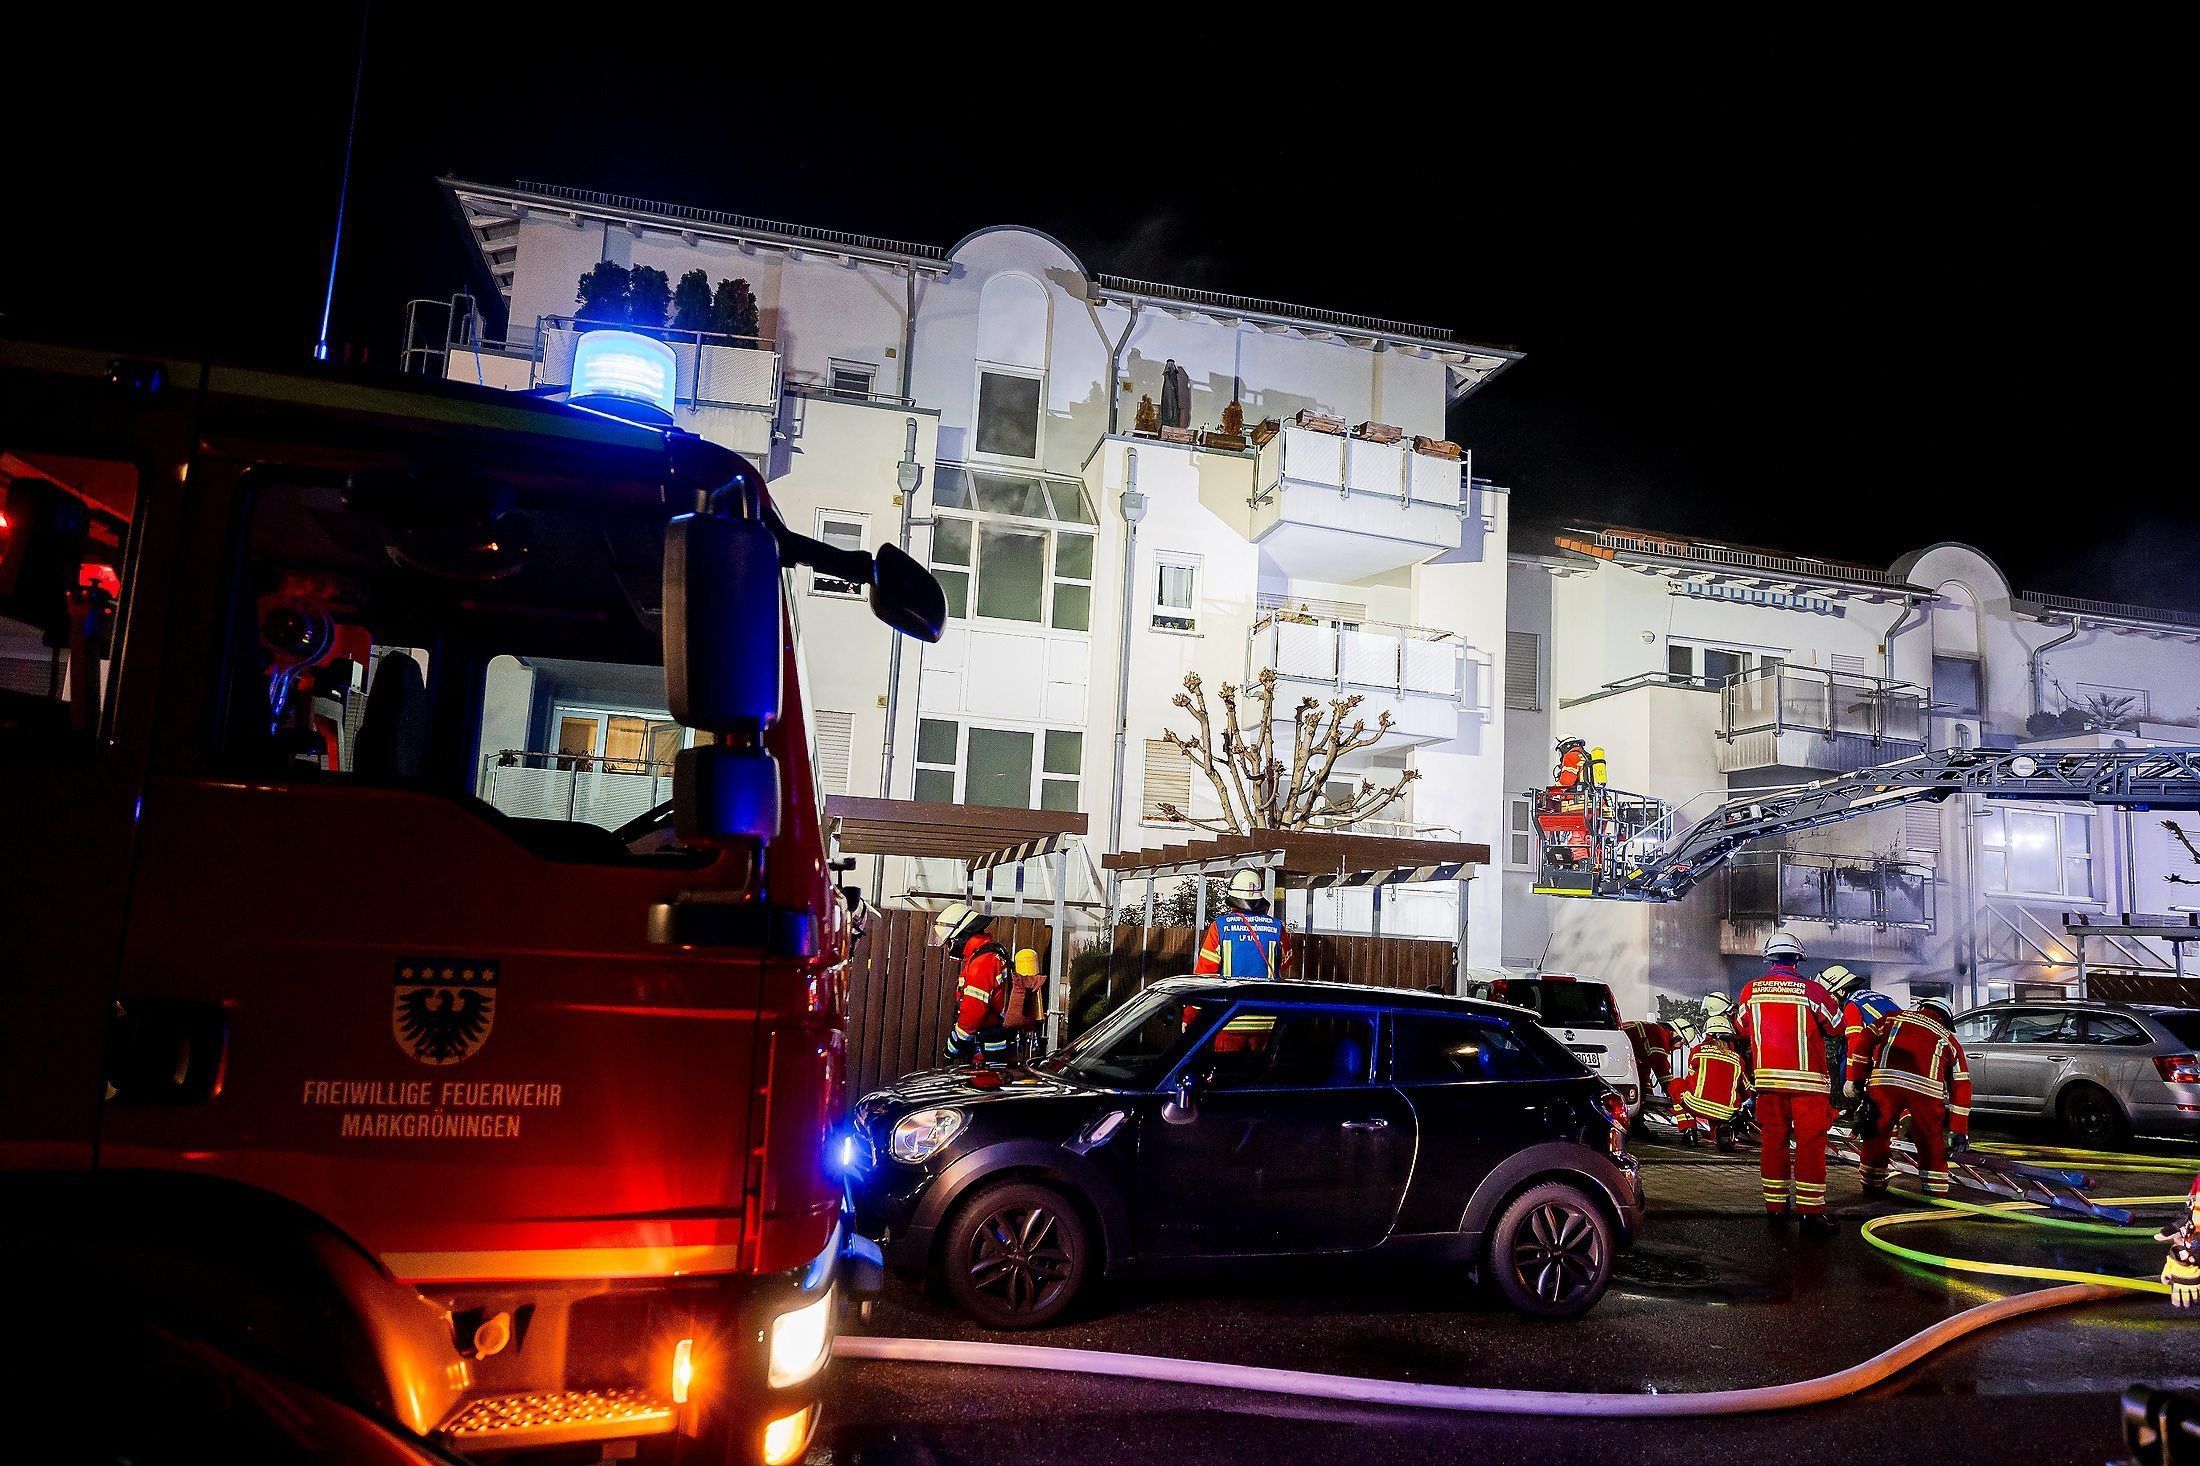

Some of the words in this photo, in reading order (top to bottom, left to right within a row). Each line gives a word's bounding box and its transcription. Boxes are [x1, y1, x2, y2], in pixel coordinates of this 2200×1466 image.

[1752, 986, 1806, 995] MARKGRÖNINGEN
[303, 1079, 432, 1105] FREIWILLIGE
[441, 1082, 562, 1107] FEUERWEHR
[341, 1107, 520, 1138] MARKGRÖNINGEN
